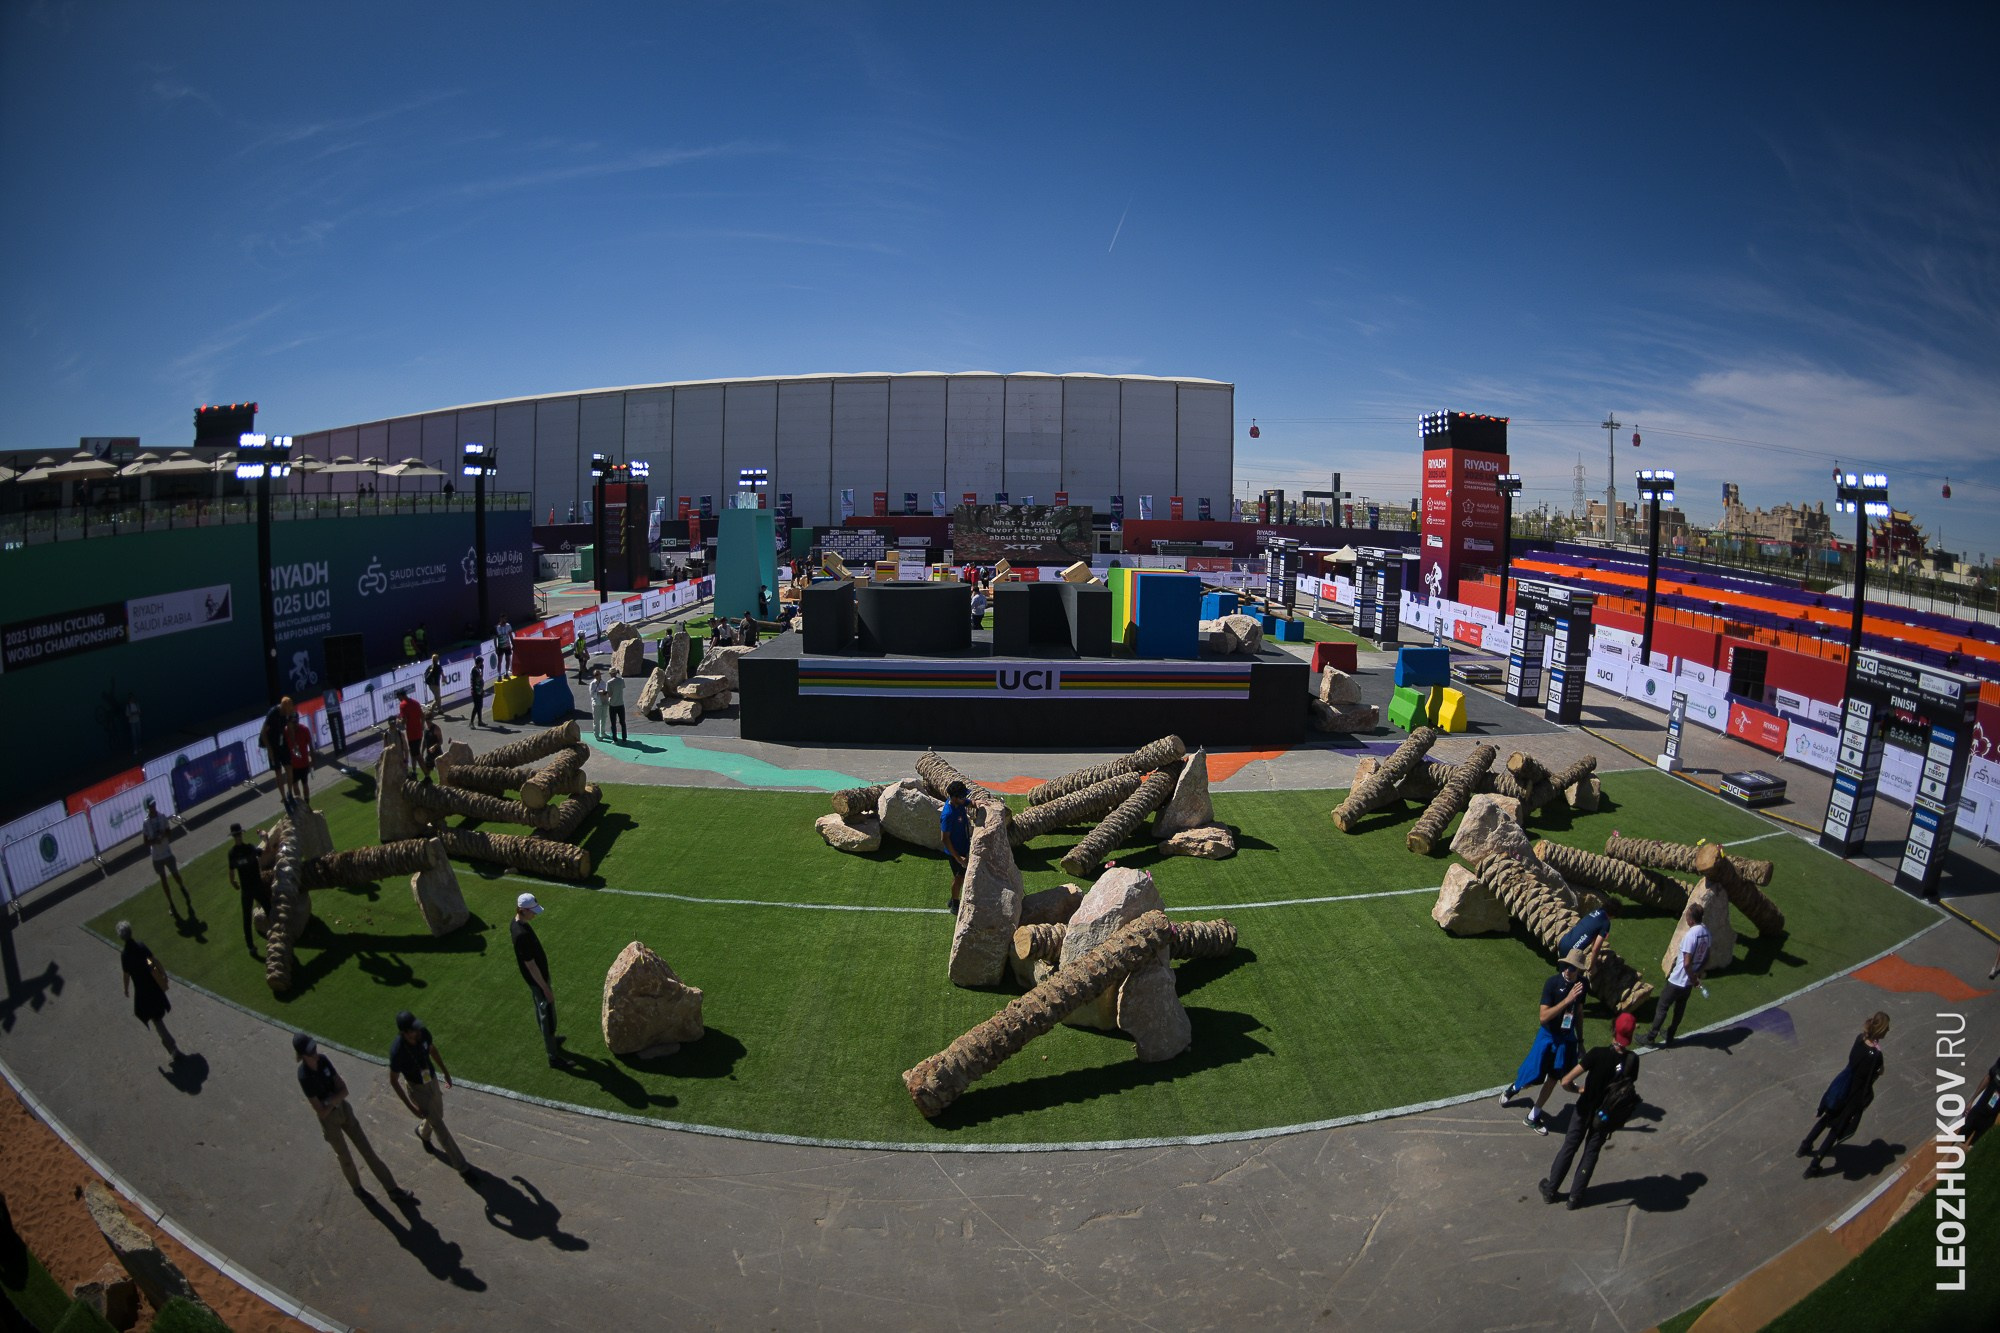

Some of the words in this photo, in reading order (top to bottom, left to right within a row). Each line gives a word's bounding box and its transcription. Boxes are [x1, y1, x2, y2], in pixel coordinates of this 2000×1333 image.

[1428, 459, 1446, 469] RIYADH
[1464, 459, 1499, 472] RIYADH
[1034, 527, 1061, 535] thing
[486, 552, 507, 565] الرياضة
[508, 551, 523, 563] وزارة
[390, 568, 414, 581] SAUDI
[416, 564, 447, 577] CYCLING
[274, 594, 301, 617] 025
[304, 589, 330, 611] UCI
[1535, 603, 1549, 612] FINISH
[132, 602, 165, 618] RIYADH
[5, 632, 28, 646] 2025
[29, 622, 62, 641] URBAN
[64, 613, 105, 632] CYCLING
[133, 617, 162, 634] SAUDI
[162, 612, 193, 627] ARABIA
[1436, 628, 1440, 636] 3
[7, 643, 43, 663] WORLD
[45, 624, 125, 654] CHAMPIONSHIPS
[1860, 659, 1876, 672] UCI
[1600, 670, 1613, 681] UCI
[1878, 669, 1890, 677] WORLD
[1890, 672, 1918, 685] CHAMPIONSHIPS
[1898, 668, 1912, 677] CYCLING
[999, 671, 1052, 690] UCI
[1511, 676, 1519, 684] UCI
[328, 693, 337, 705] 4
[1672, 700, 1684, 708] START
[1891, 695, 1917, 712] FINISH
[1673, 707, 1680, 720] 4
[1853, 703, 1868, 716] UCI
[1763, 721, 1779, 732] RIYADH
[1846, 737, 1862, 747] TISSOT
[1890, 726, 1923, 747] 8:24:43
[1932, 730, 1955, 743] SHIMANO
[1844, 767, 1853, 775] UCI
[1927, 767, 1945, 779] TISSOT
[1891, 774, 1913, 787] CYCLING
[1728, 784, 1740, 796] UCI
[1761, 790, 1773, 798] UCI
[1925, 800, 1934, 809] UCI
[1833, 807, 1848, 823] UCI
[1915, 812, 1937, 827] SHIMANO
[1910, 845, 1927, 861] UCI
